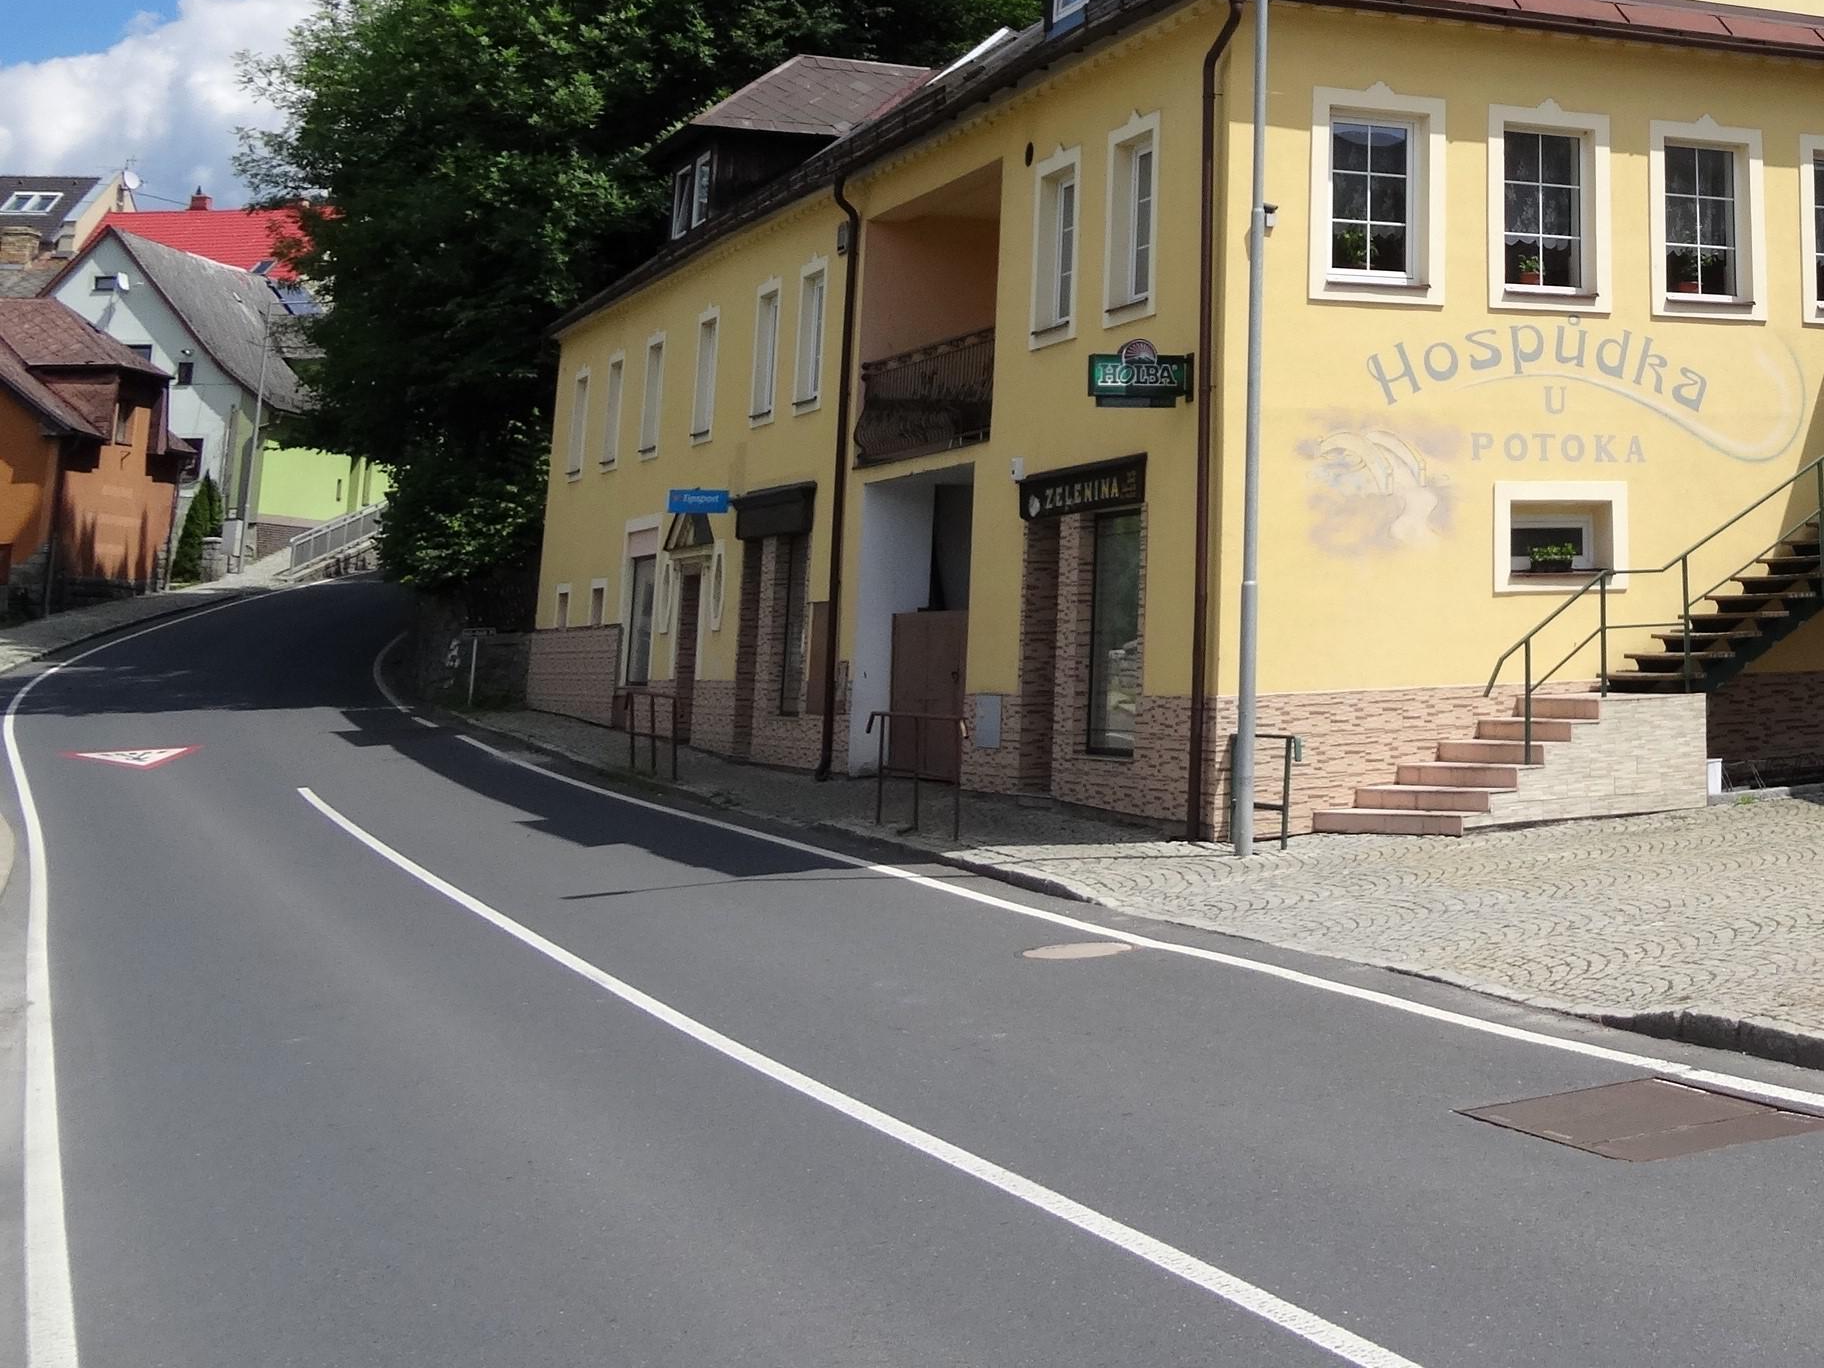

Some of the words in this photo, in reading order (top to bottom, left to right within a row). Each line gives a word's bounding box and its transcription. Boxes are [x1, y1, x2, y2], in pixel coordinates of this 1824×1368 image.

[1366, 315, 1707, 412] Hospůdka
[1544, 386, 1567, 414] U
[1471, 433, 1646, 463] POTOKA
[1045, 477, 1119, 510] ZELENINA
